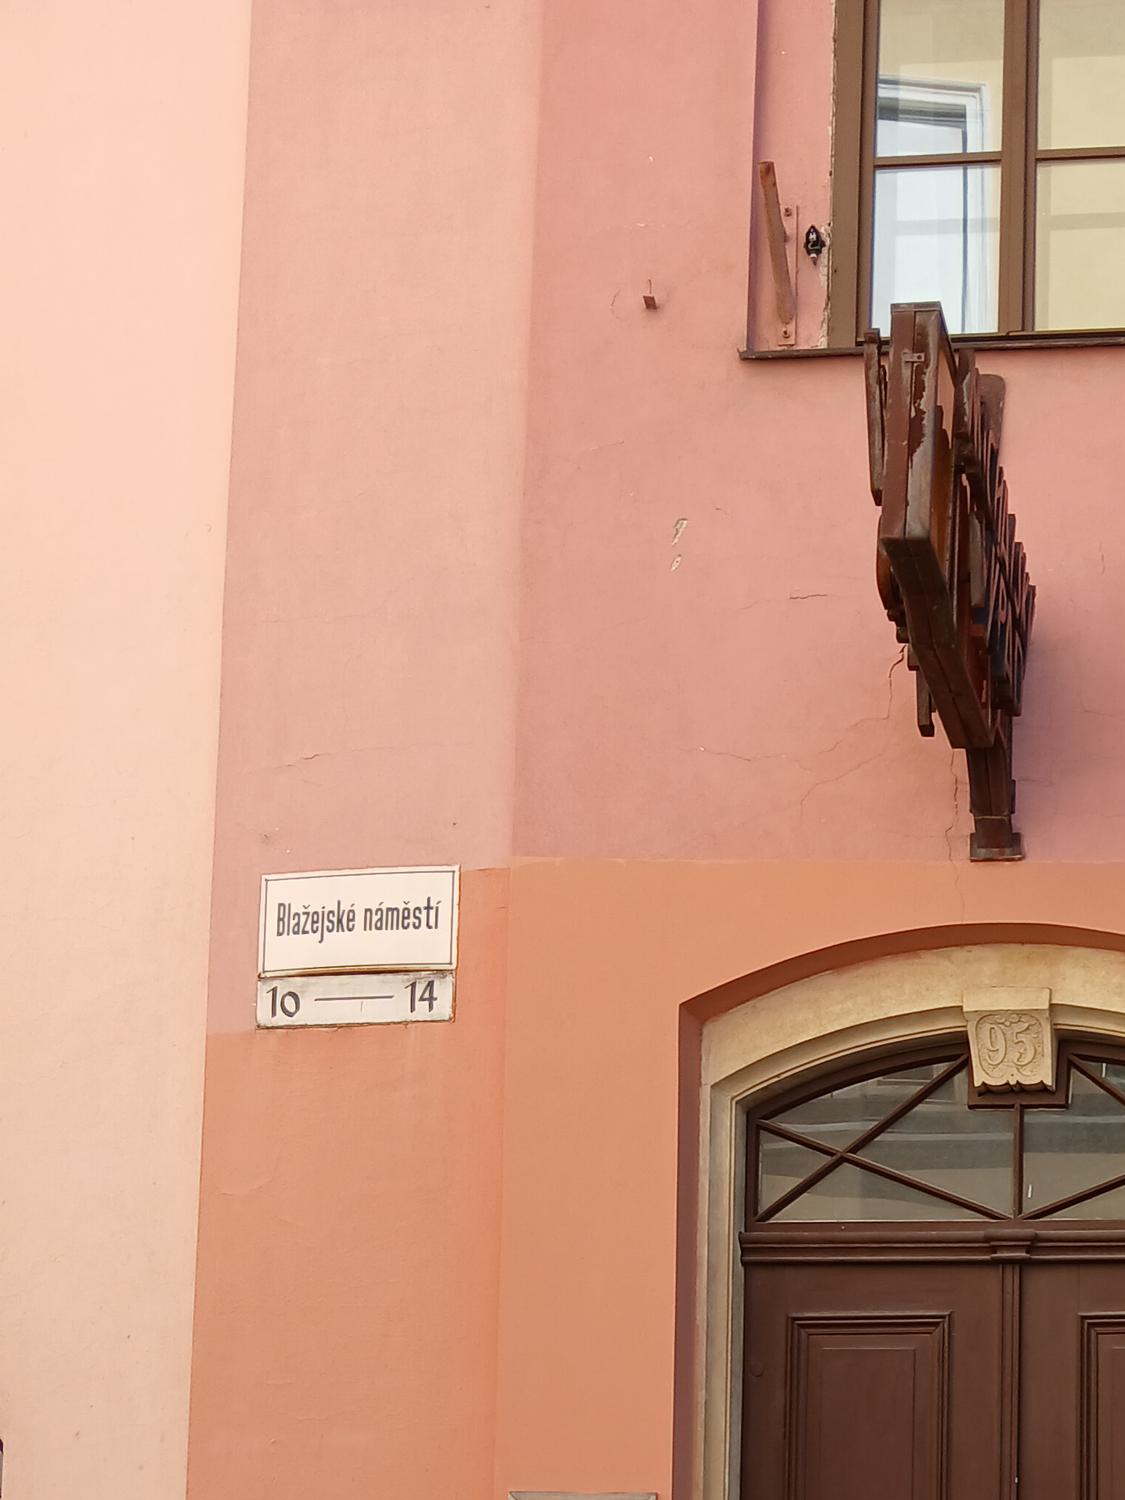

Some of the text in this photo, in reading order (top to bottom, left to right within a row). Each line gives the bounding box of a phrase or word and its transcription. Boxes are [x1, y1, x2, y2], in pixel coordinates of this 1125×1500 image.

[276, 896, 442, 944] Blažejské náměstí
[265, 979, 438, 1019] 10 14
[985, 1020, 1039, 1068] 95
